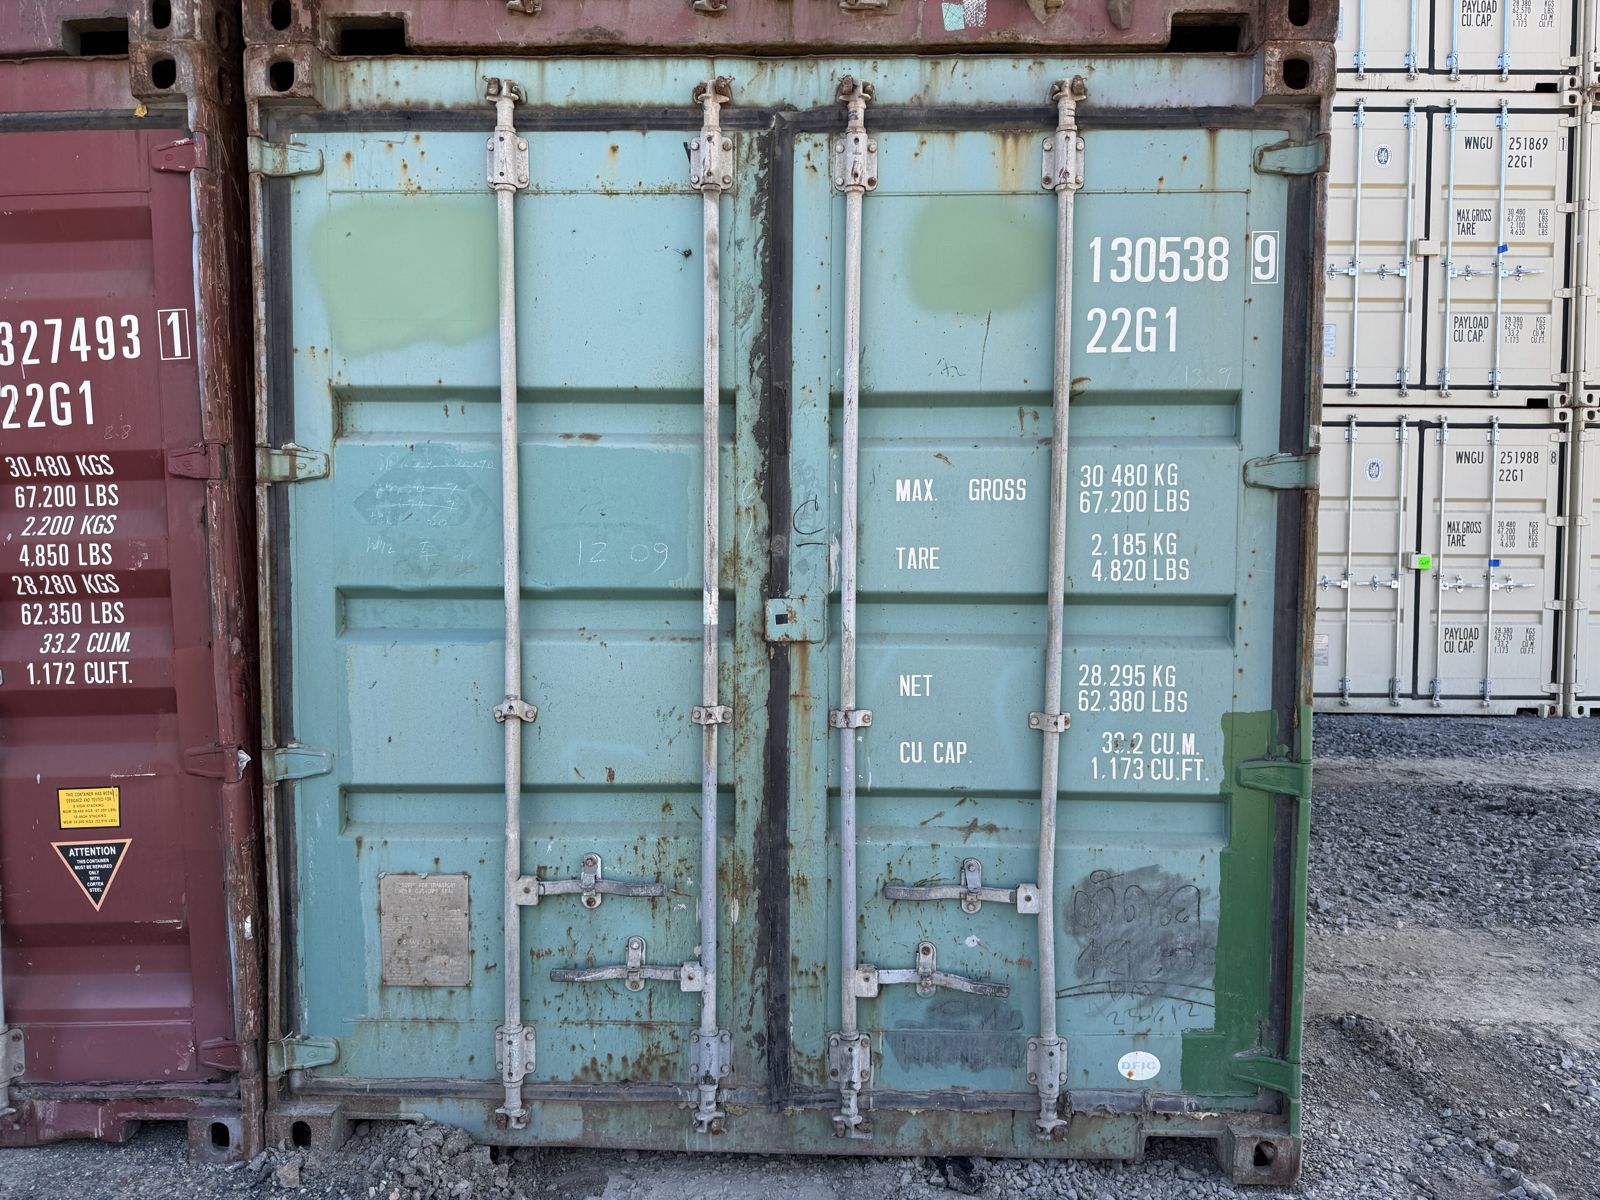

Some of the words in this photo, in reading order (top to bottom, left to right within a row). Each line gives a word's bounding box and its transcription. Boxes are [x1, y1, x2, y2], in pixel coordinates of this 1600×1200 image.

[1462, 0, 1497, 13] PAYLOAD
[1462, 14, 1474, 26] CU.
[1476, 14, 1493, 27] CAP.
[1464, 136, 1493, 150] WNGU
[1508, 136, 1548, 150] 251869
[1507, 154, 1533, 168] 22G1
[1457, 222, 1476, 236] TARE
[1088, 236, 1230, 283] 130538
[1254, 234, 1277, 281] 9
[1086, 306, 1178, 354] 22G1
[1454, 316, 1488, 329] PAYLOAD
[0, 314, 141, 366] 327493
[166, 311, 182, 357] 1
[1453, 330, 1466, 342] CU.
[1468, 330, 1485, 342] CAP.
[0, 380, 94, 430] 22G1
[75, 454, 115, 476] KGS
[1455, 450, 1484, 464] WNGU
[1500, 451, 1540, 464] 251988
[1550, 451, 1558, 465] 8
[1154, 462, 1178, 486] KG
[1498, 468, 1524, 482] 22G1
[14, 484, 76, 508] 67,200
[84, 484, 120, 507] LBS
[896, 478, 938, 502] MAX.
[968, 478, 1026, 501] GROSS
[1079, 490, 1148, 514] 67,200
[1154, 489, 1190, 513] LBS
[20, 515, 75, 536] 2,200
[80, 514, 118, 535] KGS
[1091, 532, 1146, 556] 2,185
[1153, 532, 1178, 556] KG
[1447, 534, 1466, 547] TARE
[19, 543, 69, 567] 4,850
[78, 542, 113, 566] LBS
[895, 546, 940, 570] TARE
[1091, 558, 1146, 582] 4,820
[1153, 558, 1190, 582] LBS
[81, 574, 120, 594] KGS
[20, 602, 82, 626] 62,350
[90, 602, 125, 624] LBS
[39, 632, 80, 654] 33.2
[86, 632, 131, 653] CU.M.
[1444, 627, 1479, 640] PAYLOAD
[1444, 640, 1456, 654] CU.
[1458, 640, 1476, 654] CAP.
[26, 662, 76, 685] 1,172
[84, 660, 133, 684] CU.FT.
[1078, 664, 1146, 687] 28,295
[1152, 664, 1176, 688] KG
[900, 674, 933, 697] NET
[1078, 690, 1145, 712] 62,380
[1152, 690, 1188, 713] LBS
[900, 741, 927, 764] CU.
[933, 741, 973, 764] CAP.
[1150, 732, 1201, 756] CU.M.
[1091, 756, 1144, 780] 1,173
[1150, 757, 1210, 782] CU.FT.
[68, 846, 116, 857] ATTENTION
